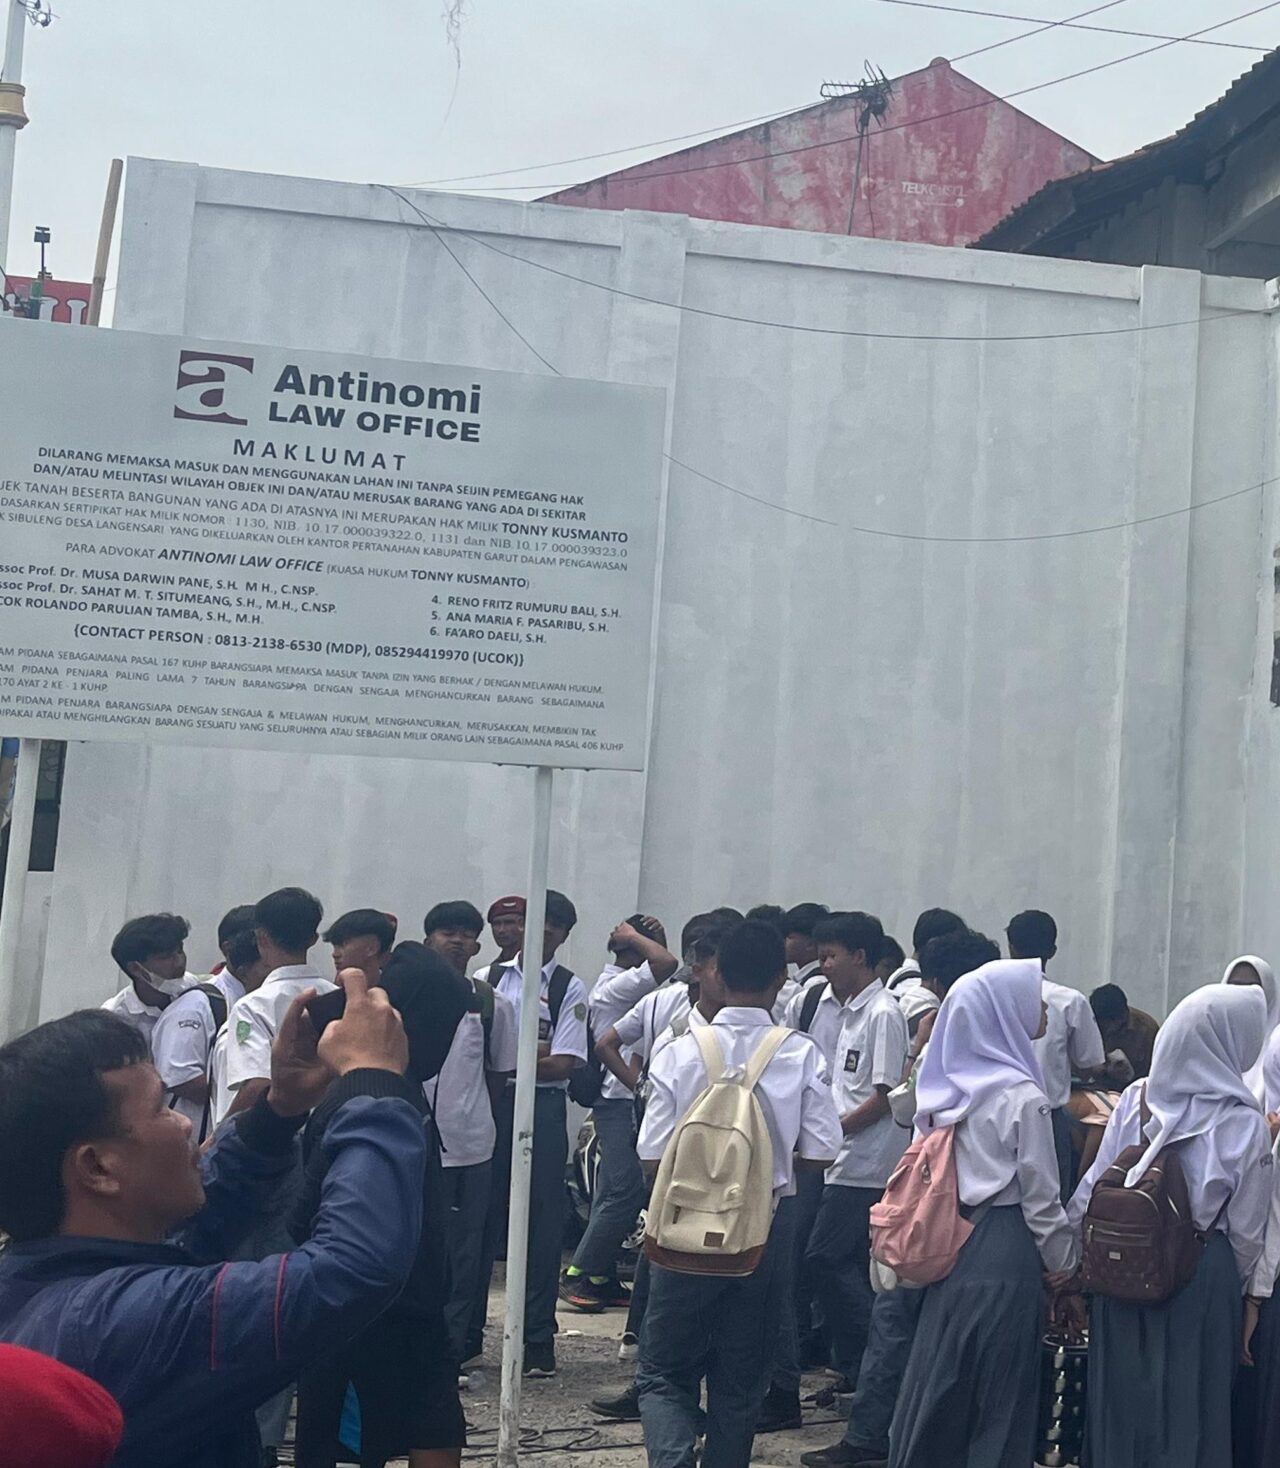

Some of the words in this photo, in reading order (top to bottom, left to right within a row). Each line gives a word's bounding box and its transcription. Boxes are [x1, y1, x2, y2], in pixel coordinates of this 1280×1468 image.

[273, 364, 481, 414] Antinomi
[268, 401, 345, 428] LAW
[356, 411, 481, 443] OFFICE
[233, 438, 406, 471] MAKLUMAT
[32, 462, 100, 479] DAN/ATAU
[101, 468, 168, 485] MELINTASI
[169, 474, 225, 490] WILAYAH
[226, 480, 265, 494] OBJEK
[267, 483, 285, 495] INI
[287, 485, 351, 501] DAN/ATAU
[352, 490, 411, 506] MERUSAK
[413, 496, 463, 511] BARANG
[465, 500, 497, 514] YANG
[498, 504, 525, 516] ADA
[526, 506, 539, 517] DI
[540, 507, 586, 521] SEKITAR
[37, 446, 103, 463] DILARANG
[105, 452, 171, 469] MEMAKSA
[173, 458, 220, 473] MASUK
[221, 463, 249, 476] DAN
[251, 466, 351, 484] MENGGUNAKAN
[352, 475, 394, 488] LAHAN
[395, 479, 414, 490] INI
[415, 480, 454, 494] TANPA
[455, 484, 490, 497] SEIJIN
[491, 487, 558, 504] PEMEGANG
[559, 494, 585, 506] HAK
[23, 481, 68, 496] TANAH
[71, 485, 125, 501] BESERTA
[127, 490, 202, 507] BANGUNAN
[204, 497, 238, 511] YANG
[239, 500, 268, 513] ADA
[269, 502, 283, 514] DI
[285, 504, 339, 519] ATASNYA
[341, 509, 358, 521] INI
[360, 510, 437, 527] MERUPAKAN
[439, 517, 464, 530] HAK
[466, 519, 499, 533] MILIK
[500, 521, 549, 537] TONNY
[550, 526, 629, 544] KUSMANTO
[7, 511, 63, 526] SIBULENG
[64, 516, 94, 529] DESA
[95, 519, 165, 534] LANGENSARI
[168, 525, 200, 537] YANG
[200, 527, 275, 544] DIKELUARKAN
[276, 533, 305, 546] OLEH
[306, 536, 350, 549] KANTOR
[351, 540, 421, 555] PERTANAHAN
[422, 546, 482, 561] KABUPATEN
[483, 551, 519, 563] GARUT
[519, 554, 557, 566] DALAM
[558, 557, 628, 572] PENGAWASAN
[65, 542, 96, 554] PARA
[98, 545, 156, 559] ADVOKAT
[156, 547, 237, 565] ANTINOMI
[238, 554, 273, 568] LAW
[274, 557, 325, 573] OFFICE
[367, 567, 408, 578] HUKUM
[409, 568, 454, 582] TONNY
[81, 568, 120, 581] MUSA
[122, 571, 175, 586] DARWIN
[24, 597, 88, 612] ROLANDO
[90, 602, 153, 617] PARULIAN
[80, 584, 122, 598] SAHAT
[447, 595, 480, 608] RENO
[481, 598, 514, 611] FRITZ
[514, 600, 568, 615] RUMURU
[445, 611, 472, 623] ANA
[473, 613, 514, 626] MARIA
[147, 629, 204, 645] PERSON
[374, 644, 470, 662] 085294419970
[20, 664, 60, 676] PIDANA
[65, 667, 109, 679] PENJARA
[114, 669, 150, 682] PALING
[155, 673, 185, 684] LAMA
[191, 674, 199, 684] 7
[203, 675, 237, 687] TAHUN
